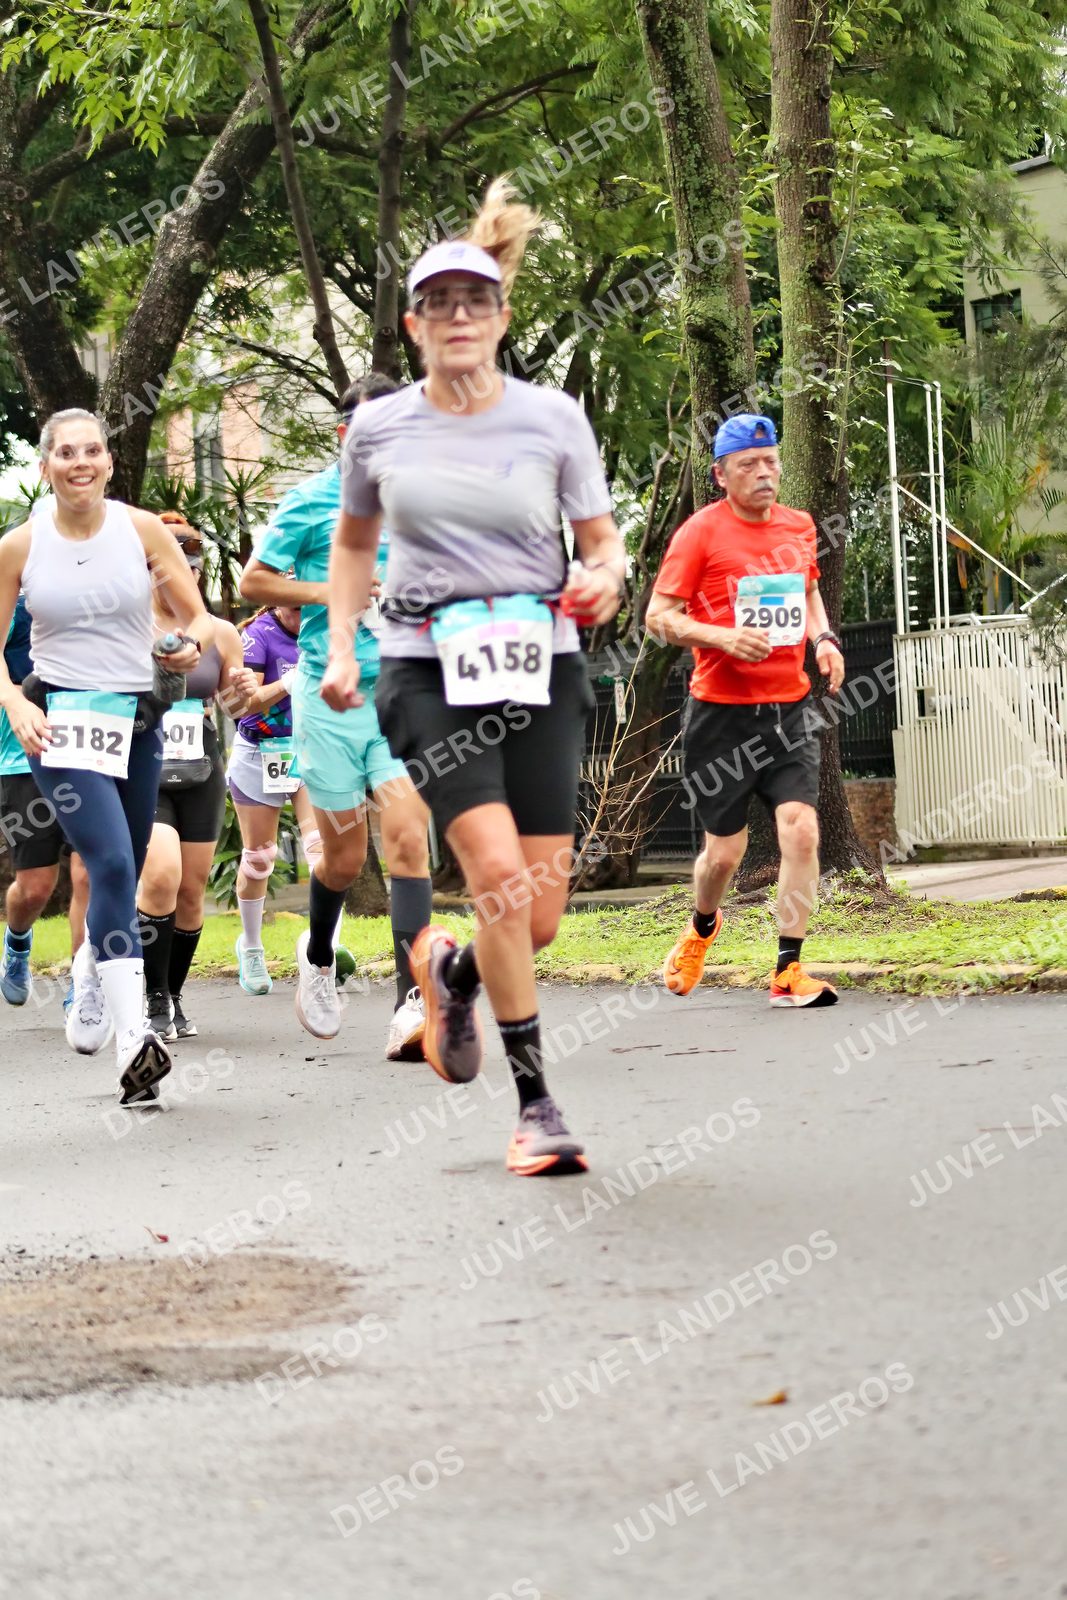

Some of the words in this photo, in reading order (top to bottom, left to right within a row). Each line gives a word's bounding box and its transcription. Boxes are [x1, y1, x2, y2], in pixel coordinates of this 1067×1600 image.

[741, 606, 802, 628] 2909
[457, 640, 541, 681] 4158
[49, 724, 124, 757] 5182
